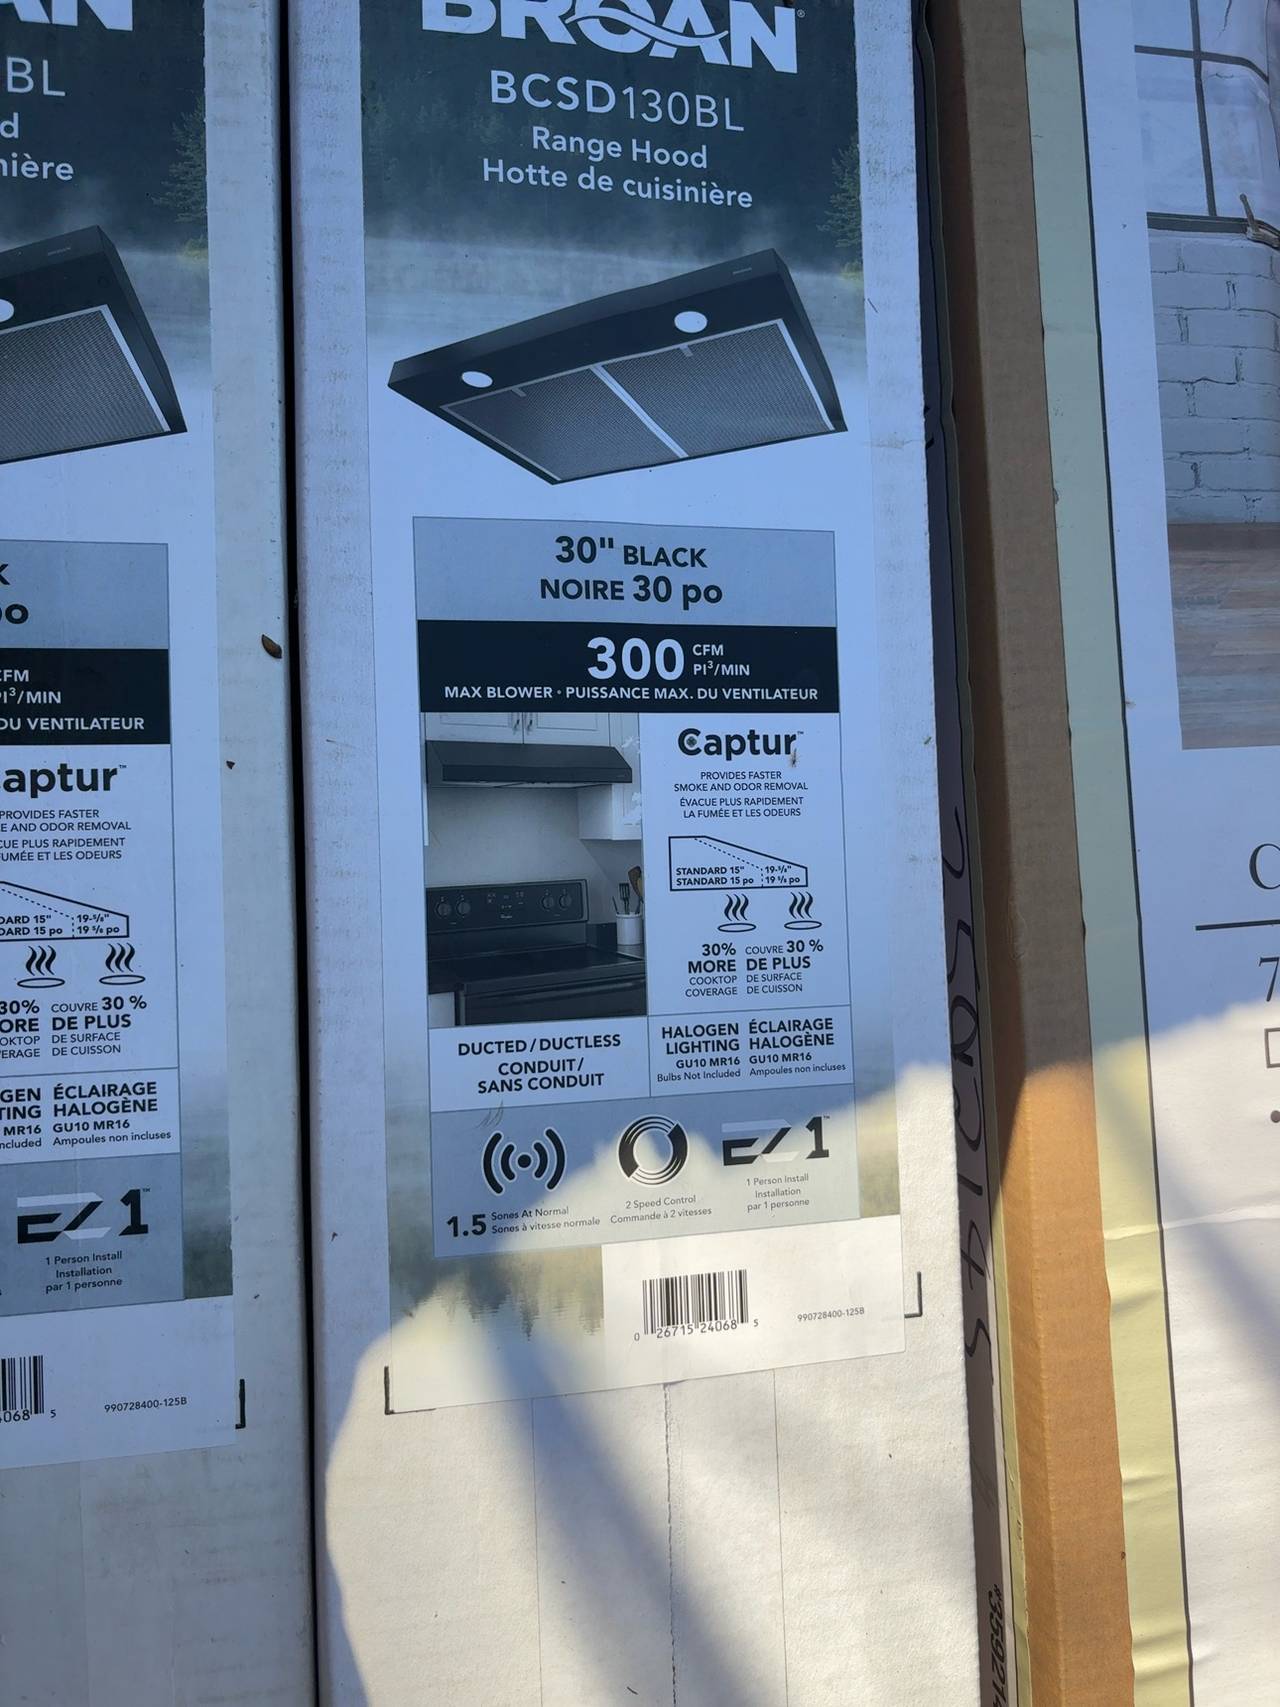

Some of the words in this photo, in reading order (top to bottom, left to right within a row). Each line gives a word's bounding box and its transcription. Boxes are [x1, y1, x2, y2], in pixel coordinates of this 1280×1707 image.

[490, 69, 744, 132] BCSD130BL
[533, 126, 622, 162] Range
[632, 139, 707, 168] Hood
[483, 158, 567, 187] Hotte
[578, 165, 613, 192] de
[623, 177, 752, 208] cuisinière
[555, 536, 614, 564] 30"
[623, 545, 707, 568] BLACK
[540, 579, 624, 600] NOIRE
[633, 575, 672, 603] 30
[682, 584, 723, 611] po
[693, 644, 723, 656] CFM
[587, 637, 684, 680] 300
[445, 686, 482, 698] MAX
[487, 686, 552, 698] BLOWER
[566, 687, 650, 699] PUISSANCE
[654, 688, 693, 699] MAX.
[697, 688, 718, 699] DU
[722, 688, 818, 700] VENTILATEUR
[27, 717, 144, 730] VENTILATEUR
[701, 771, 746, 780] PROVIDES
[748, 771, 782, 780] FASTER
[674, 783, 708, 792] SMOKE
[710, 783, 731, 791] AND
[733, 782, 762, 791] ODOR
[764, 782, 808, 791] REMOVAL
[680, 797, 717, 807] ÉVACUE
[719, 797, 742, 806] PLUS
[744, 796, 804, 806] RAPIDEMENT
[58, 809, 99, 819] FASTER
[683, 810, 696, 818] LA
[698, 808, 730, 818] FUMÉE
[732, 809, 743, 818] ET
[745, 808, 761, 817] LES
[763, 808, 801, 817] ODEURS
[10, 823, 37, 832] AND
[39, 822, 74, 832] ODOR
[77, 821, 131, 831] REMOVAL
[22, 839, 49, 848] PLUS
[52, 837, 125, 848] RAPIDEMENT
[37, 851, 51, 861] ET
[53, 851, 73, 860] LES
[75, 850, 122, 860] ODEURS
[676, 866, 727, 876] STANDARD
[676, 877, 727, 886] STANDARD
[743, 878, 754, 886] po
[765, 876, 776, 885] 19
[789, 877, 801, 886] po
[34, 926, 47, 936] 15
[49, 928, 63, 937] po
[77, 926, 89, 934] 19
[106, 927, 120, 935] po
[702, 942, 736, 956] 30%
[745, 945, 784, 955] COUVRE
[786, 940, 805, 953] 30
[809, 939, 824, 952] %
[688, 959, 736, 974] MORE
[746, 958, 767, 971] DE
[772, 956, 811, 970] PLUS
[689, 975, 737, 986] COOKTOP
[746, 974, 759, 983] DE
[761, 972, 802, 982] SURFACE
[685, 986, 738, 997] COVERAGE
[747, 986, 759, 994] DE
[761, 984, 803, 994] CUISSON
[51, 1002, 98, 1013] COUVRE
[102, 996, 124, 1011] 30
[129, 995, 147, 1009] %
[52, 1016, 78, 1031] DE
[85, 1014, 131, 1029] PLUS
[749, 1018, 833, 1034] ÉCLAIRAGE
[52, 1034, 67, 1044] DE
[70, 1032, 120, 1043] SURFACE
[662, 1023, 739, 1039] HALOGEN
[666, 1038, 740, 1055] LIGHTING
[749, 1031, 834, 1050] HALOGÈNE
[52, 1047, 68, 1056] DE
[70, 1044, 121, 1055] CUISSON
[676, 1058, 706, 1069] GU10
[709, 1056, 740, 1067] MR16
[749, 1054, 779, 1064] GU10
[782, 1052, 812, 1062] MR16
[657, 1073, 682, 1082] Bulbs
[684, 1072, 701, 1080] Not
[703, 1068, 741, 1079] Included
[749, 1066, 793, 1078] Ampoules
[813, 1063, 846, 1072] incluses
[54, 1081, 157, 1100] ÉCLAIRAGE
[478, 1078, 523, 1094] SANS
[528, 1073, 604, 1090] CONDUIT
[53, 1097, 158, 1117] HALOGÈNE
[3, 1125, 41, 1136] MR16
[53, 1121, 89, 1133] GU10
[93, 1119, 130, 1130] MR16
[52, 1134, 106, 1147] Ampoules
[131, 1131, 171, 1141] incluses
[753, 1177, 782, 1186] Person
[784, 1173, 809, 1183] Install
[755, 1187, 801, 1198] Installation
[626, 1200, 631, 1209] 2
[633, 1197, 661, 1211] Speed
[663, 1194, 696, 1206] Control
[747, 1204, 761, 1213] par
[770, 1199, 810, 1211] personne
[491, 1212, 519, 1221] Sones
[521, 1209, 532, 1218] At
[535, 1206, 569, 1217] Normal
[610, 1211, 661, 1224] Commande
[663, 1210, 668, 1219] à
[670, 1209, 676, 1218] 2
[677, 1208, 712, 1217] vitesses
[447, 1214, 486, 1237] 1.5
[491, 1225, 519, 1234] Sones
[522, 1222, 527, 1231] à
[529, 1221, 561, 1231] vitesse
[563, 1216, 600, 1227] normale
[45, 1257, 50, 1266] 1
[54, 1256, 90, 1265] Person
[93, 1250, 122, 1261] Install
[56, 1266, 112, 1278] Installation
[46, 1284, 63, 1294] par
[74, 1279, 122, 1292] personne
[797, 1307, 865, 1322] 990728400-125B
[634, 1332, 640, 1341] 0
[656, 1324, 694, 1339] 26715
[700, 1320, 737, 1334] 24068
[753, 1318, 759, 1327] 5
[104, 1397, 187, 1413] 990728400-125B
[50, 1409, 56, 1418] 5
